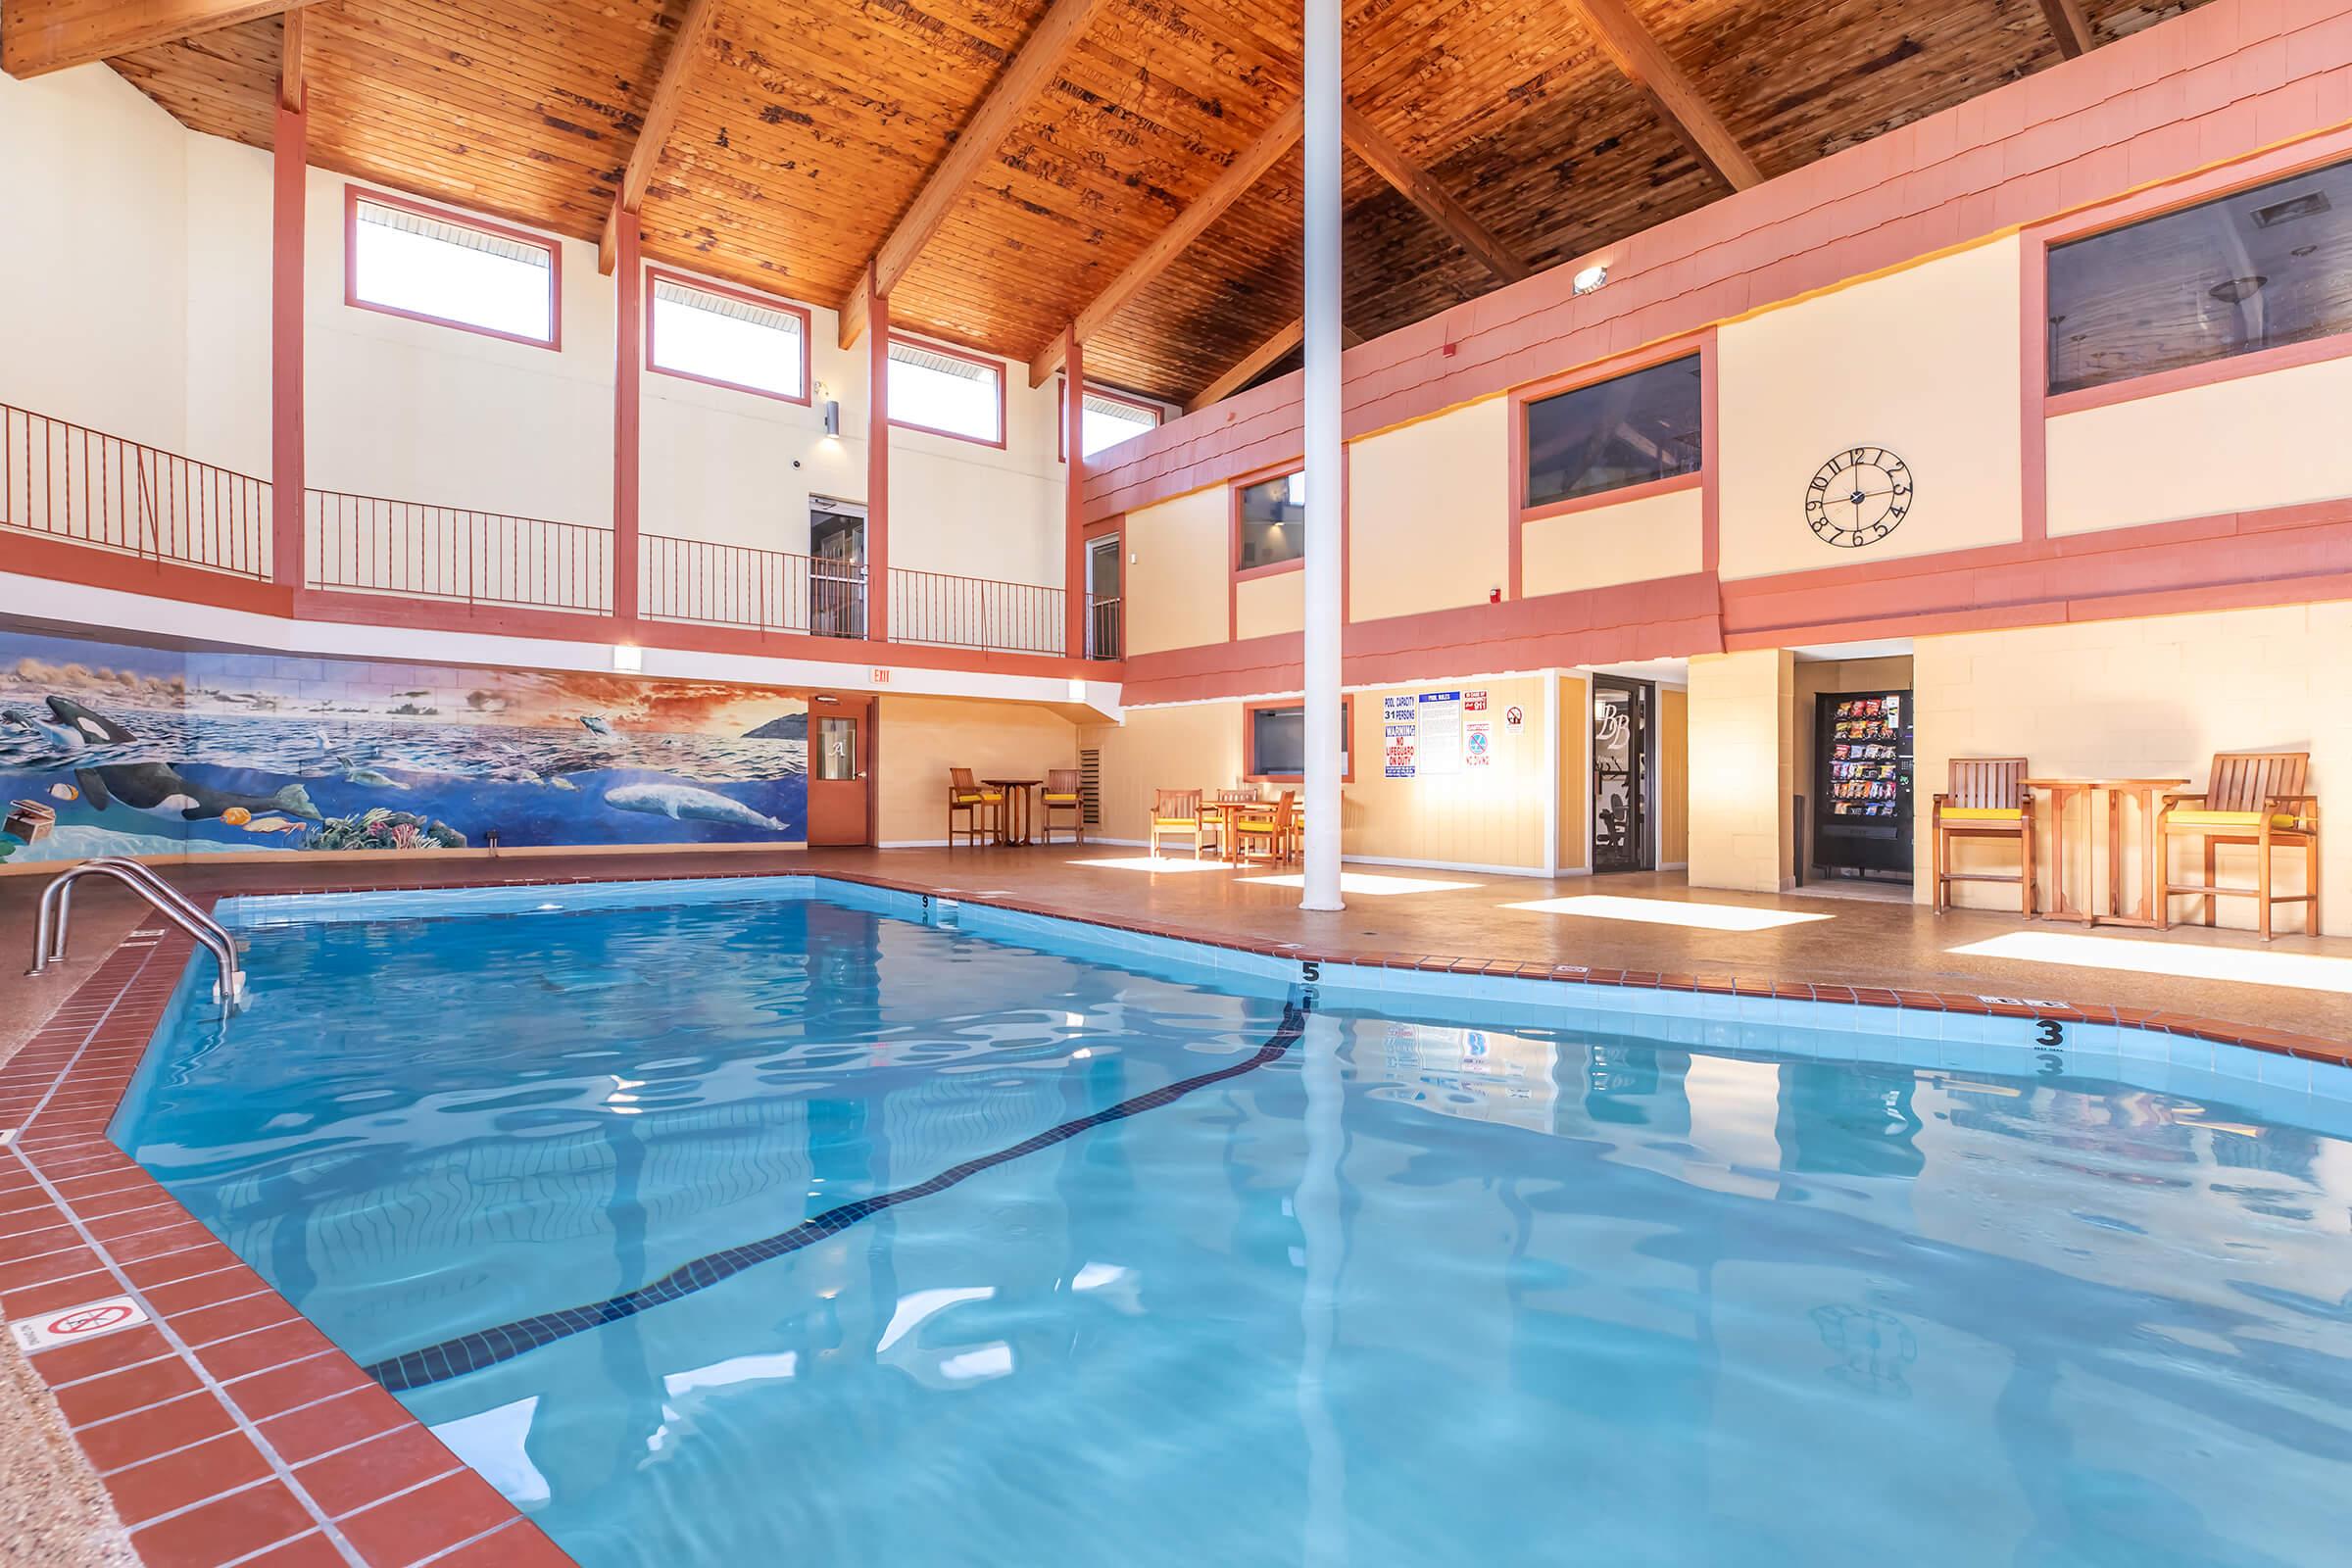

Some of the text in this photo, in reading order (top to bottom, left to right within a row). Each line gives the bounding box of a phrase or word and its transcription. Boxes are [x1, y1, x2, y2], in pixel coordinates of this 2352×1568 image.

[1849, 448, 1865, 466] 12
[1827, 458, 1842, 475] 11
[1886, 460, 1905, 478] 2
[1810, 476, 1829, 491] 10
[1893, 481, 1913, 496] 3
[1806, 500, 1823, 511] 9
[1889, 506, 1906, 518] 4
[1812, 516, 1829, 532] 8
[1873, 520, 1888, 538] 5
[1829, 527, 1844, 543] 7
[1853, 529, 1864, 547] 6
[874, 669, 890, 682] EXIT
[1385, 696, 1415, 708] POOL CAPACITY
[1385, 710, 1415, 720] 31 PERSONS
[1386, 726, 1415, 736] WARNING
[1396, 737, 1403, 746] NO
[1387, 746, 1414, 756] LIFEGUARD
[1390, 757, 1411, 765] ON DUTY
[922, 895, 929, 908] 9
[1302, 961, 1320, 982] 5
[2035, 1019, 2064, 1047] 3
